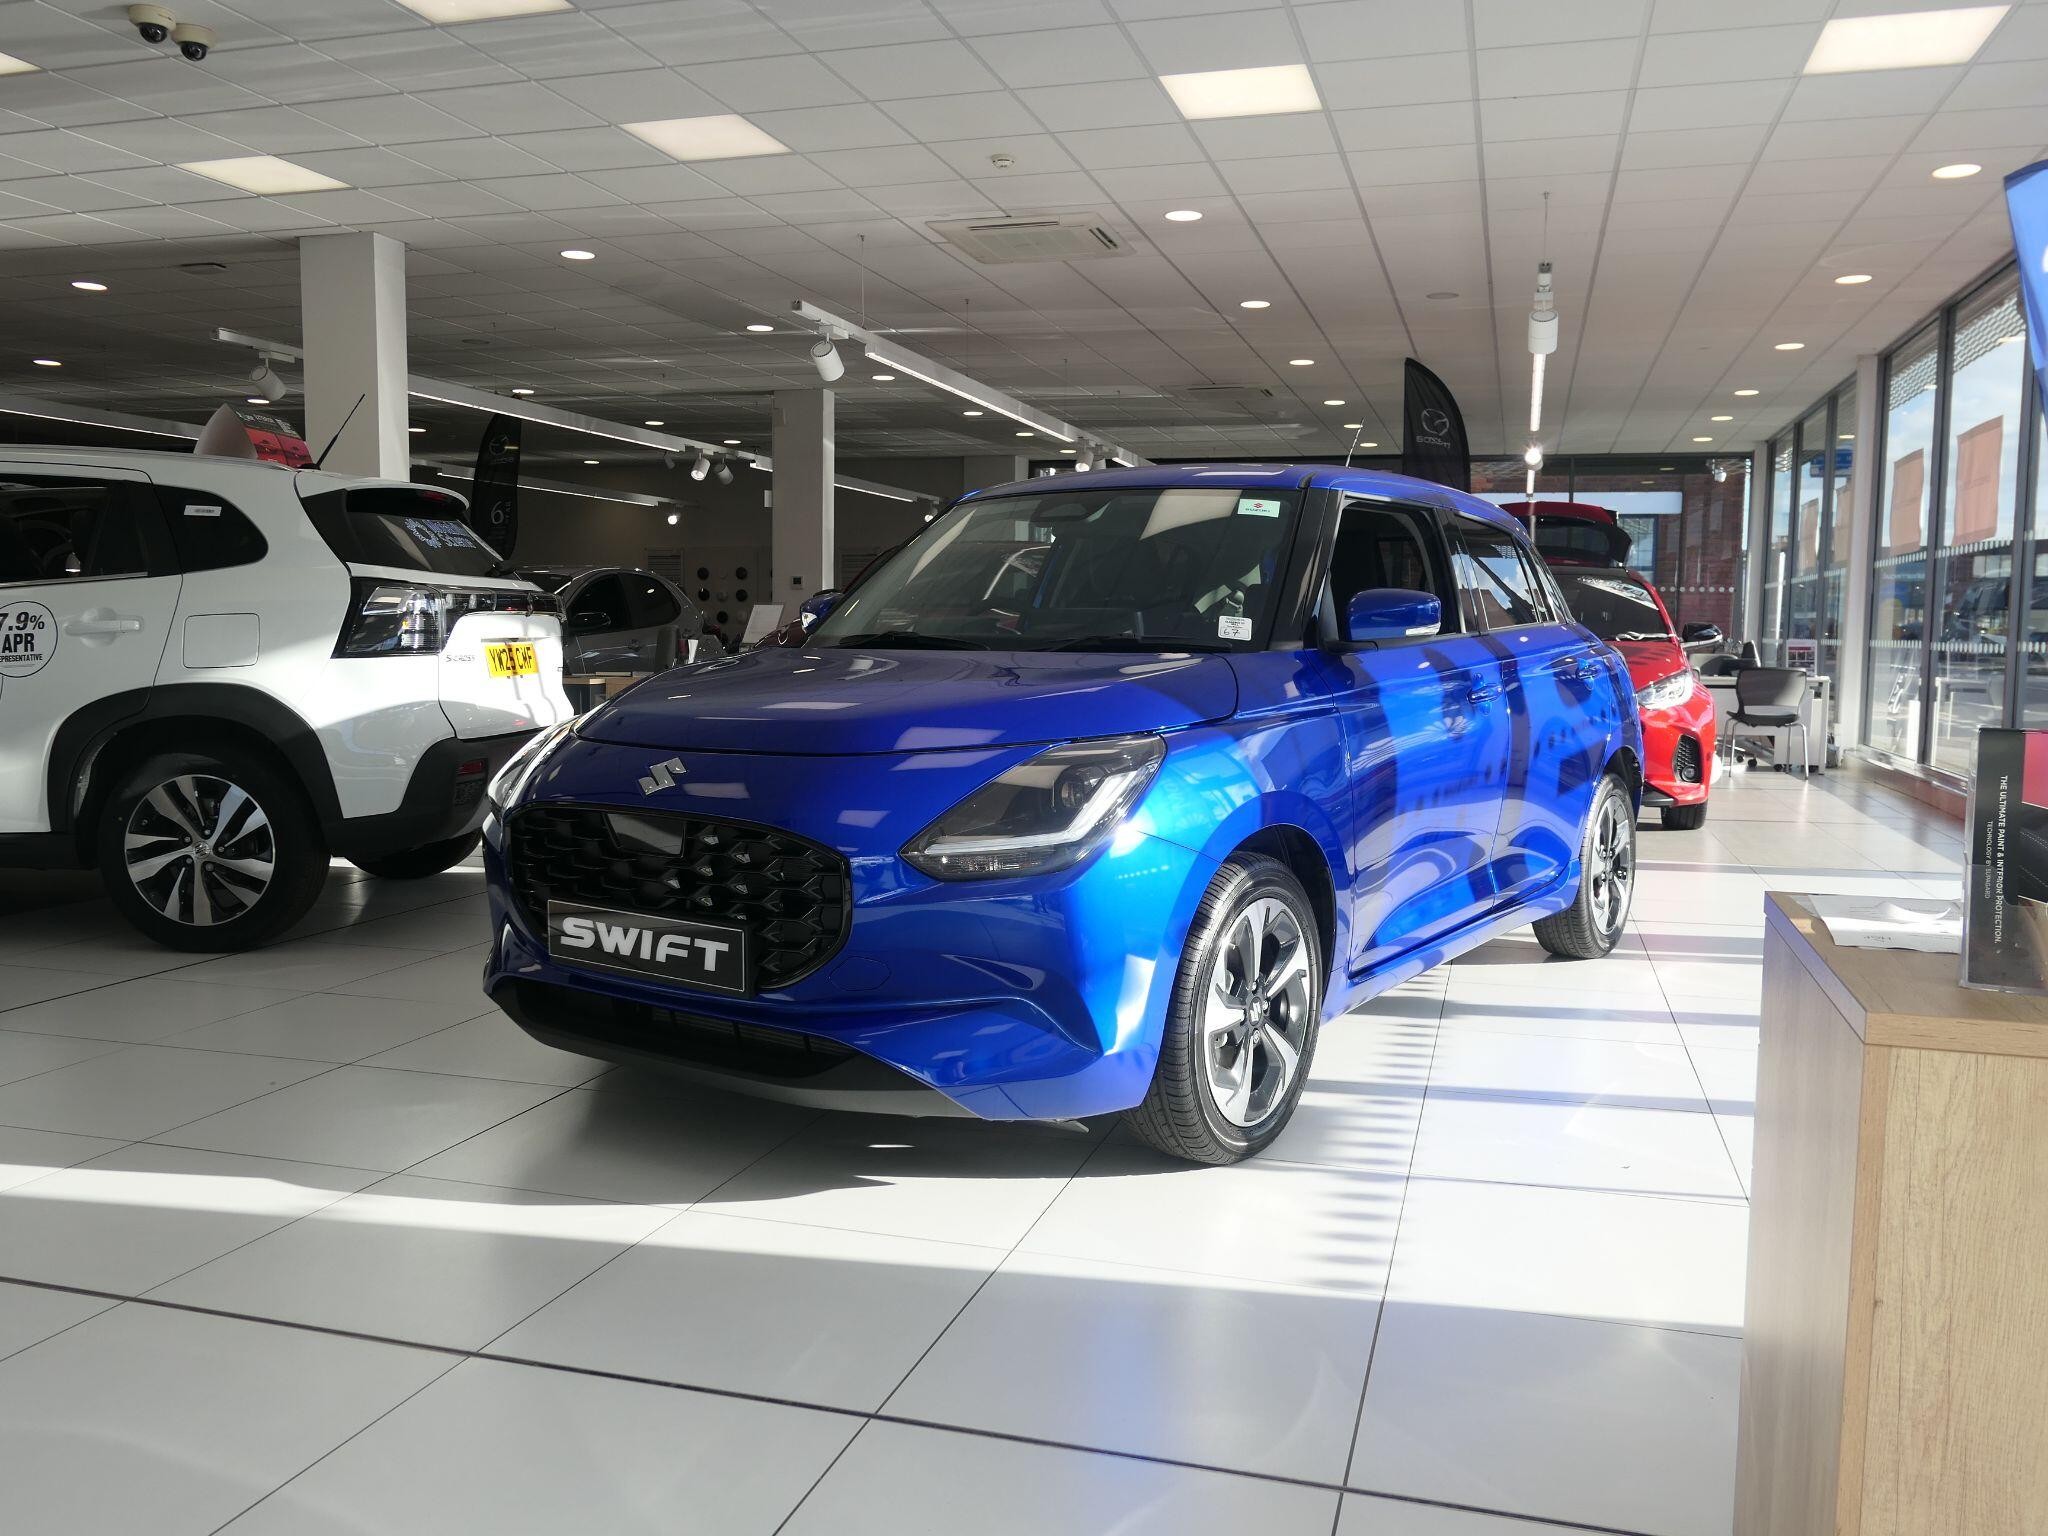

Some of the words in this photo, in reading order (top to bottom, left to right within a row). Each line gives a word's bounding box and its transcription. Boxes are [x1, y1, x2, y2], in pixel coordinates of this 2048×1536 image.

[0, 611, 45, 631] 7.9%
[2, 633, 35, 653] APR
[0, 653, 43, 662] EPRESENTATIVE
[2000, 776, 2008, 789] THE
[1998, 792, 2007, 827] ULTIMATE
[1985, 821, 1993, 858] TECHNOLOGY
[1997, 829, 2005, 850] PAINT
[561, 917, 729, 971] SWIFT
